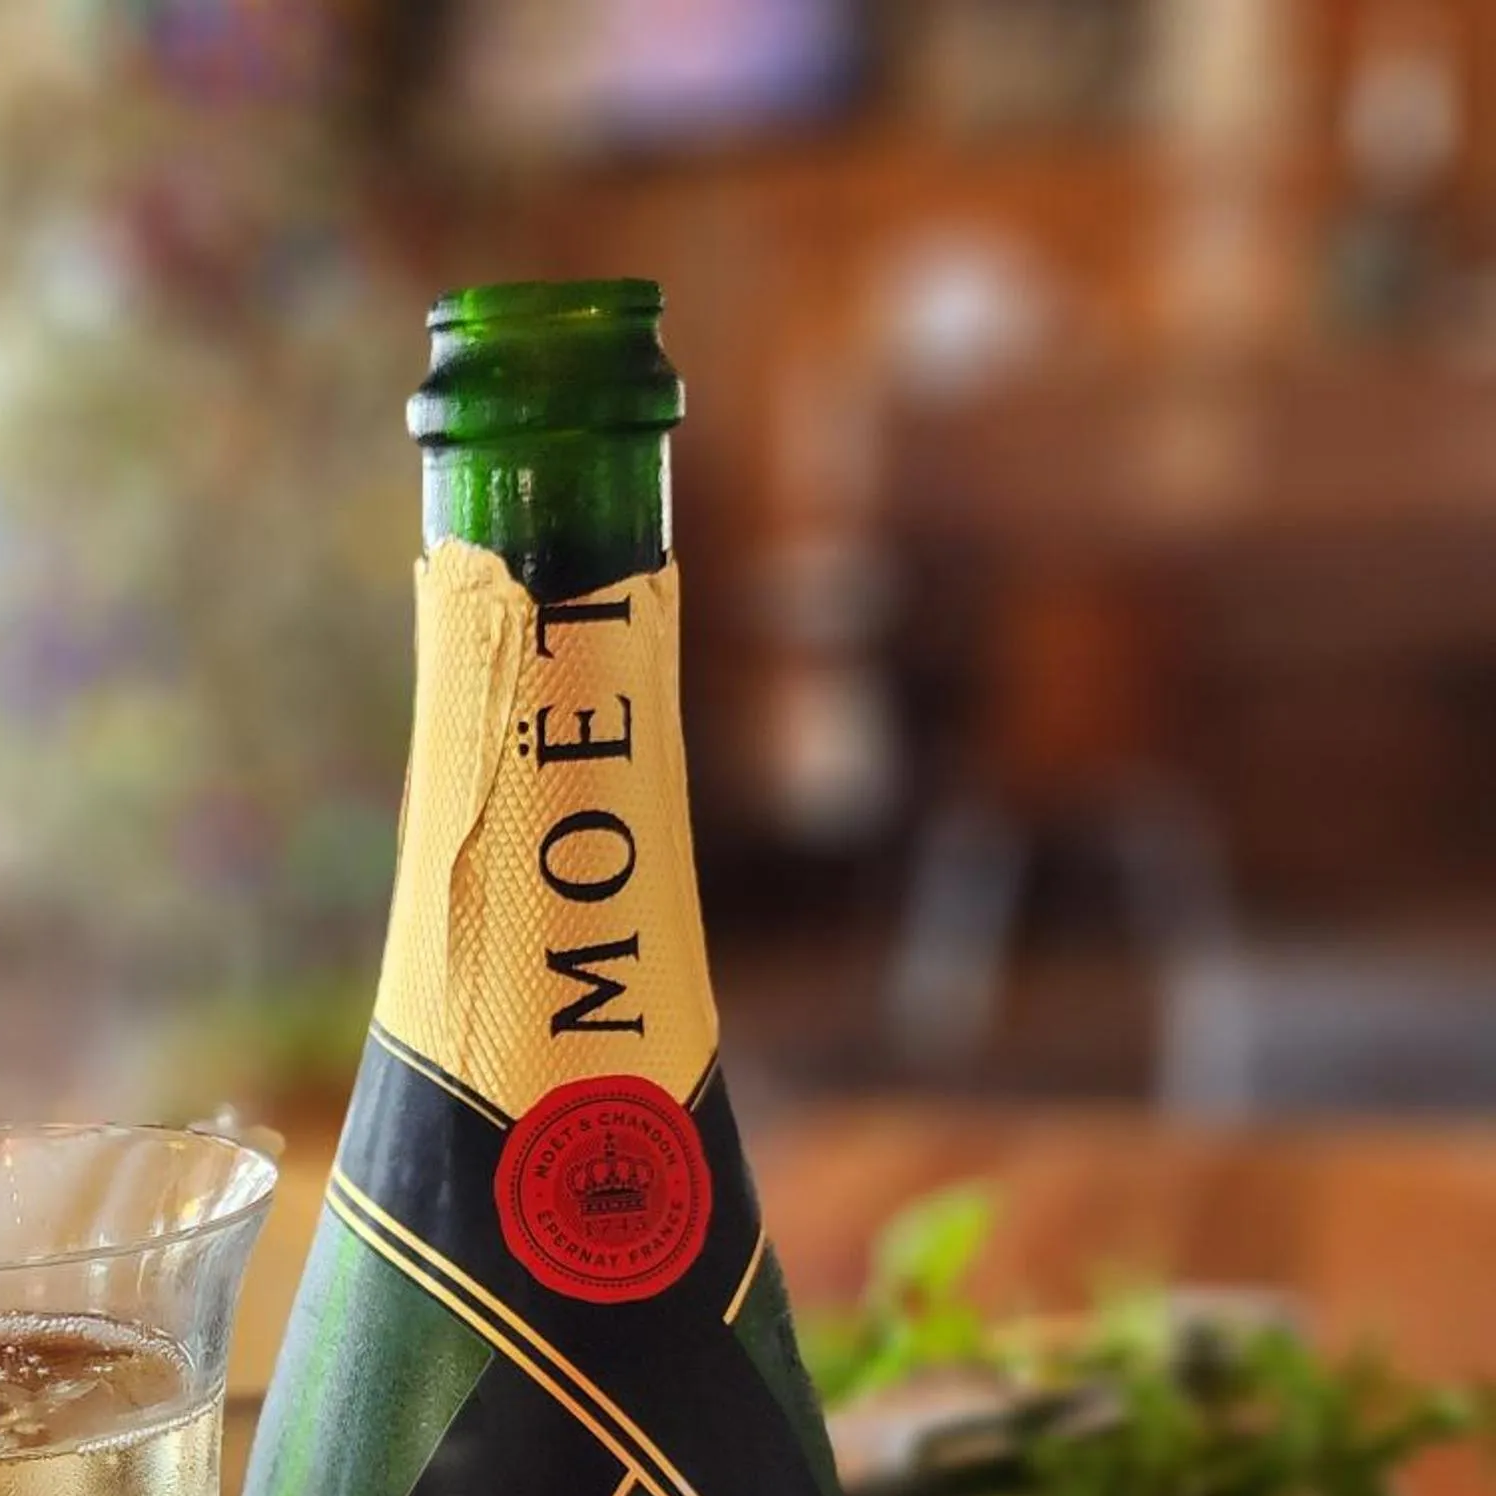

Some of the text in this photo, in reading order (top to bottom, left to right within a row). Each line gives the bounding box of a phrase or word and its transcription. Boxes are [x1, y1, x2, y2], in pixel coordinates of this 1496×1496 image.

[517, 594, 645, 1039] MOËT
[598, 1111, 677, 1166] CHANDON
[628, 1200, 684, 1265] FRANCE
